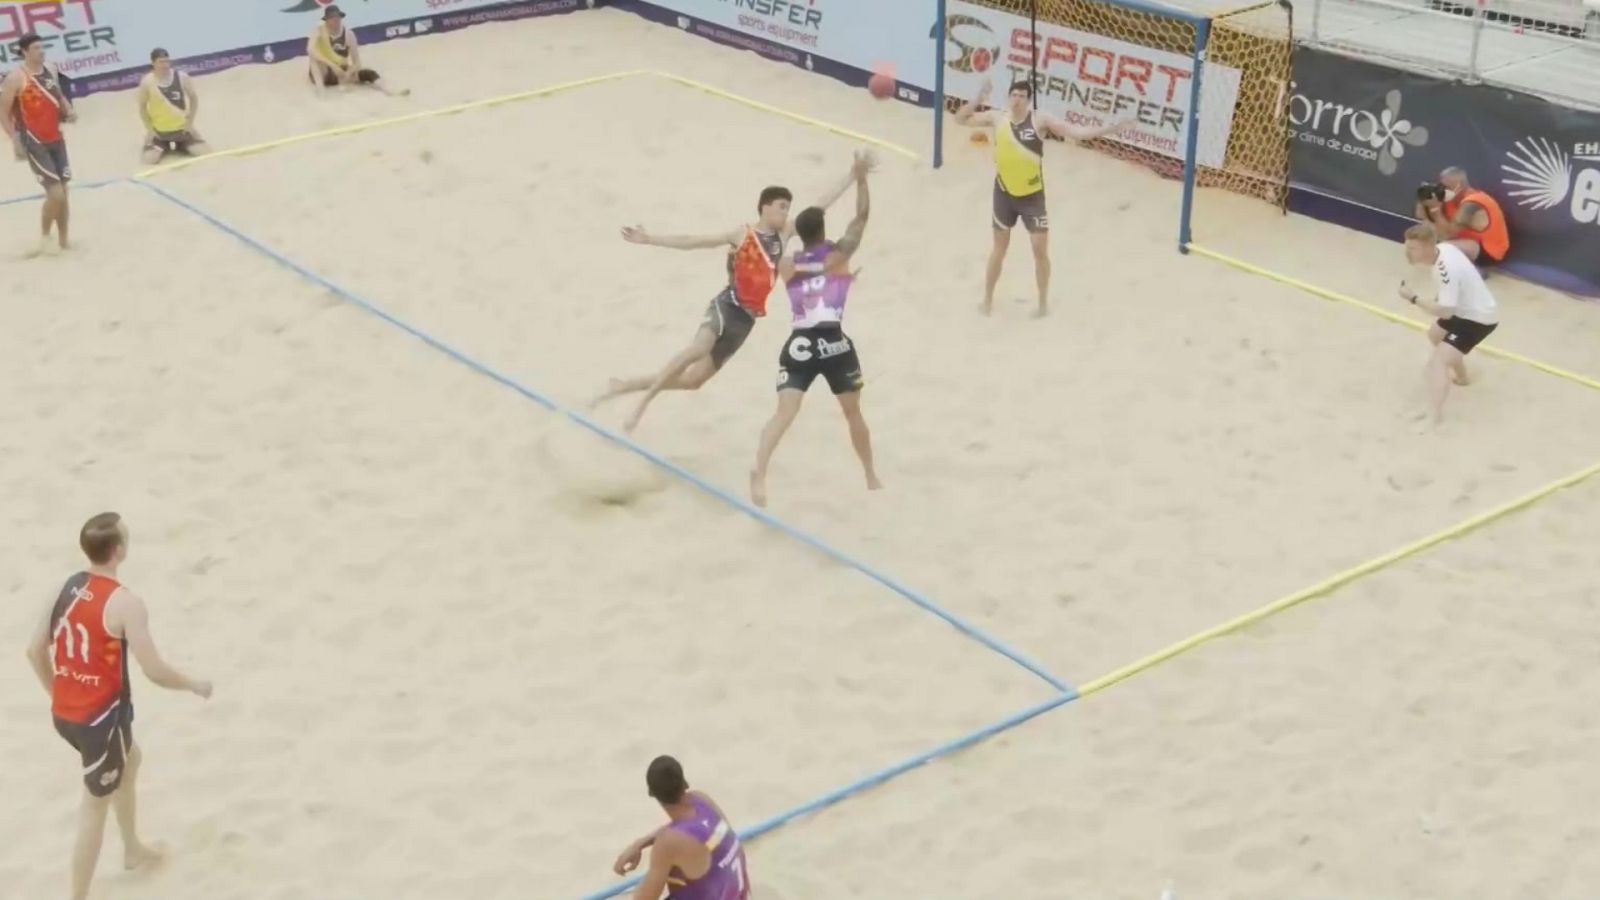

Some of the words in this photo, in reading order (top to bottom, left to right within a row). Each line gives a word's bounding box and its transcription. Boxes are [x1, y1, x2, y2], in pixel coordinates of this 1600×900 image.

[1007, 27, 1192, 103] SPORT
[1006, 64, 1185, 132] TRANSFER
[1019, 129, 1036, 141] 12
[1573, 142, 1600, 155] EH
